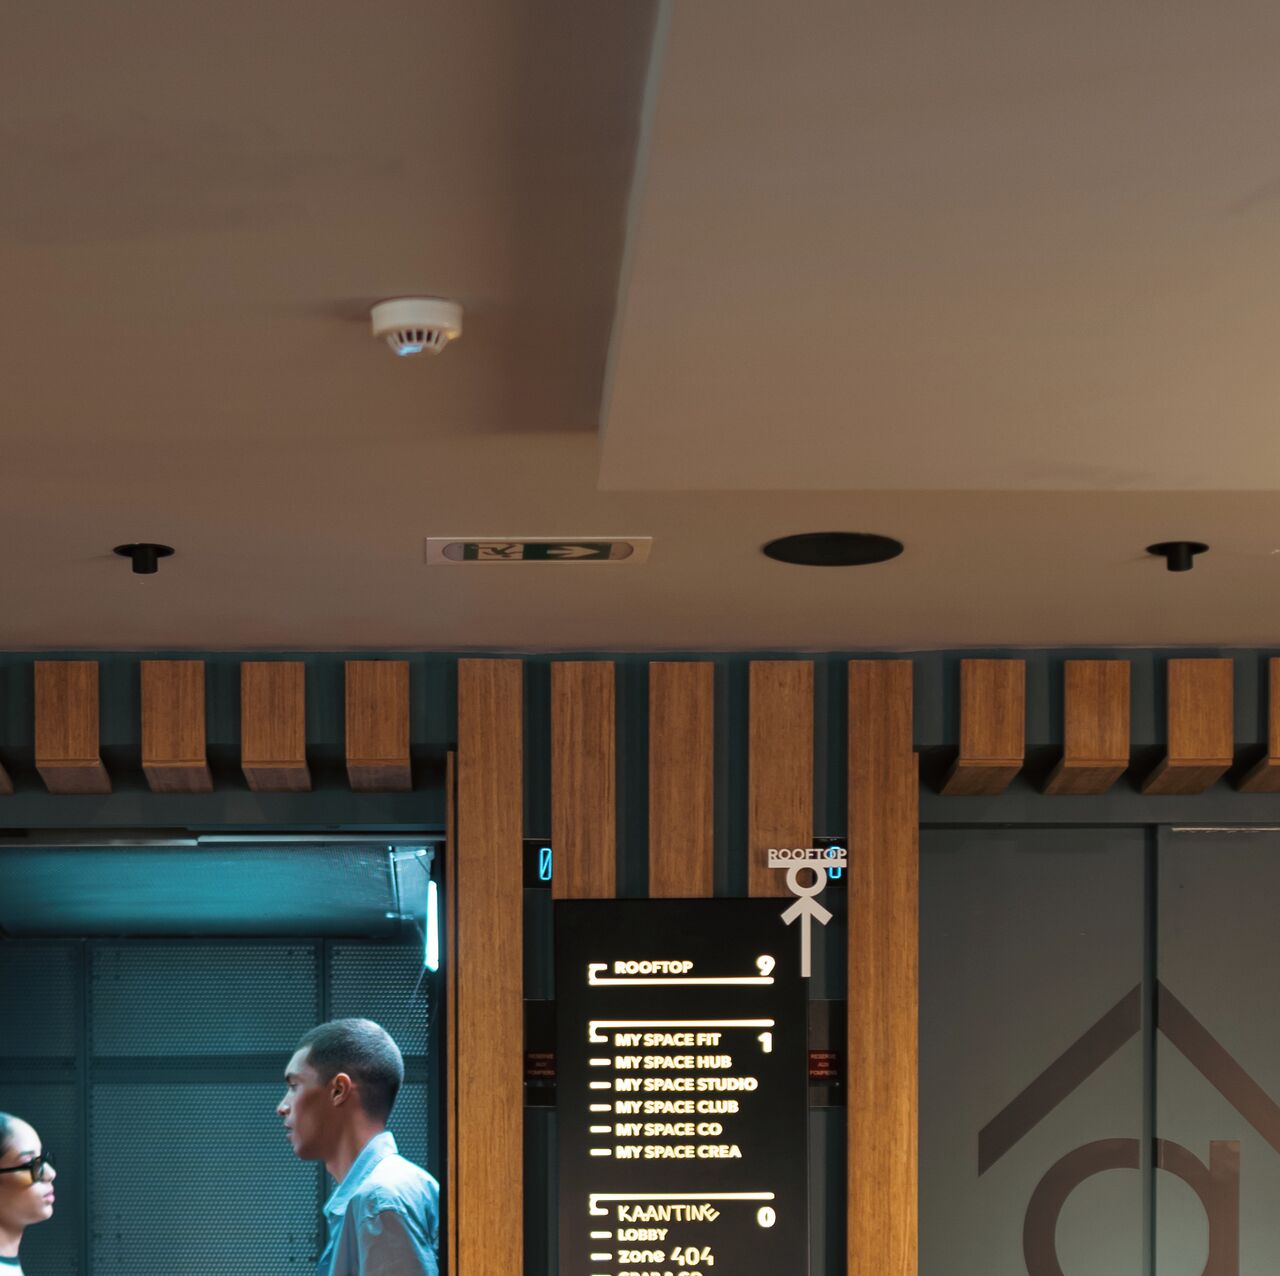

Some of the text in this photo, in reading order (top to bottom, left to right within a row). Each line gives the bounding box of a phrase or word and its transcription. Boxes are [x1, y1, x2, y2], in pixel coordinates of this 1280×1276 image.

[768, 848, 847, 860] ROOFTOP
[615, 955, 776, 977] ROOFTOP 9
[615, 1033, 722, 1047] MY SPACE FIT
[757, 1032, 773, 1053] 1
[615, 1055, 732, 1070] MY SPACE HUB
[615, 1076, 759, 1092] MY SPACE STUDIO
[615, 1100, 740, 1115] MY SPACE CLUB
[615, 1122, 723, 1137] MY SPACE CO
[615, 1145, 743, 1160] MY SPACE CREA
[618, 1203, 720, 1222] KAANTINE
[757, 1206, 776, 1228] 0
[617, 1228, 668, 1241] LOBBY
[618, 1246, 714, 1266] zone 404
